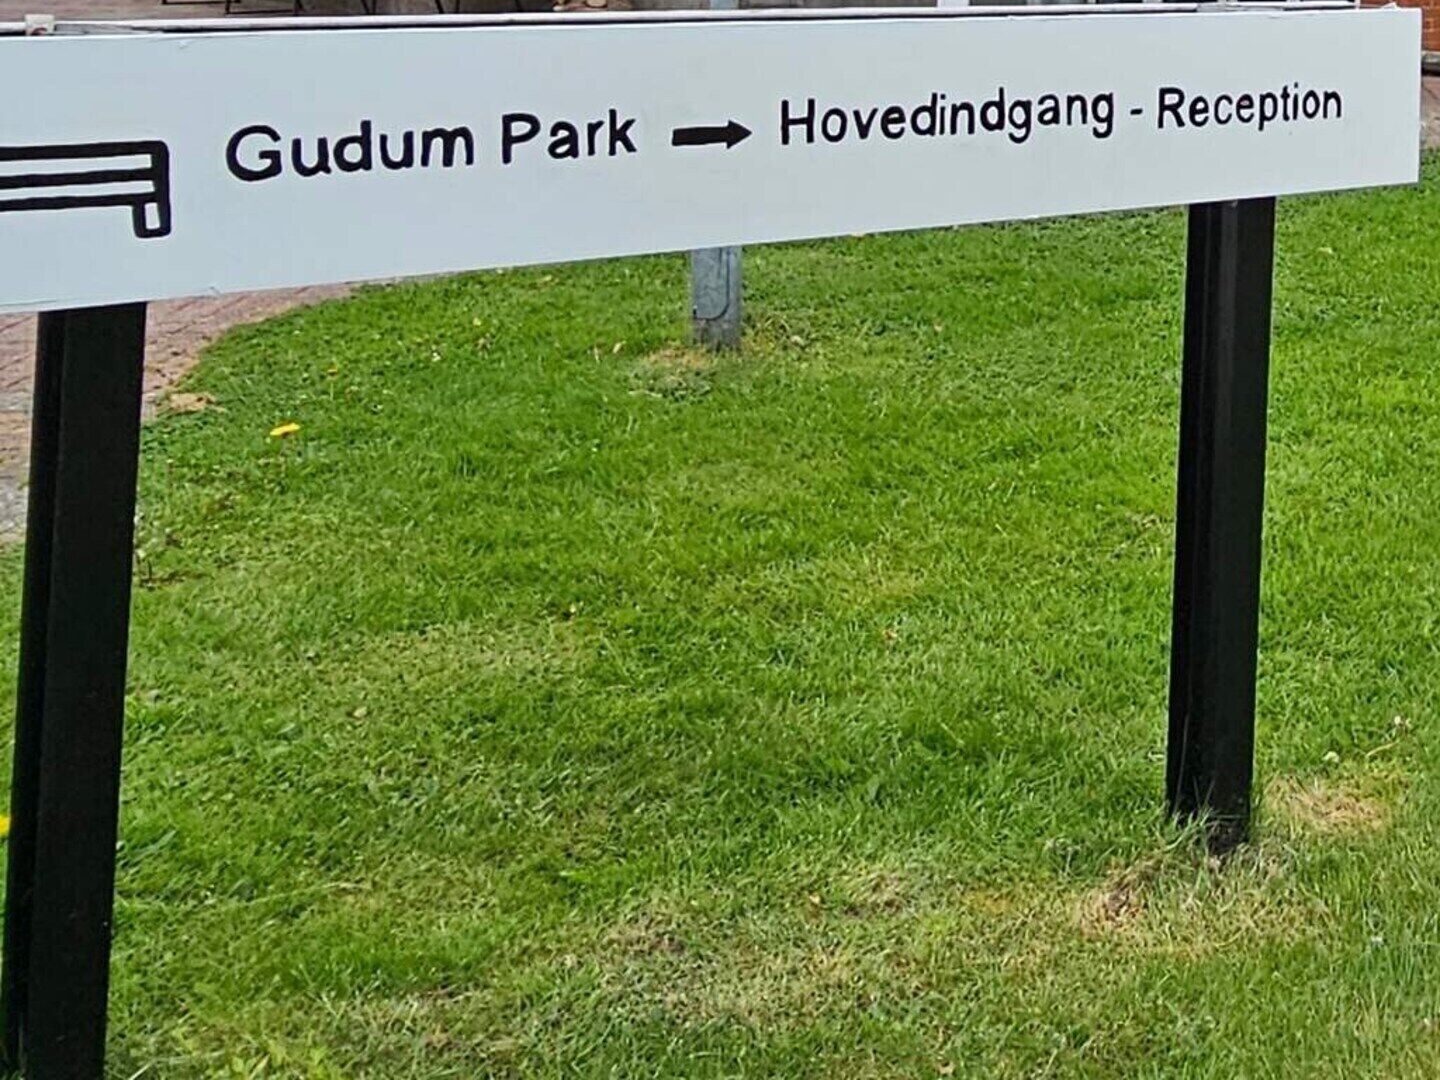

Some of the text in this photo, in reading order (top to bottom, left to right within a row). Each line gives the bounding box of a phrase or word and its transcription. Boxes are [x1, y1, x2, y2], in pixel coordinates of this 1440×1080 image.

[226, 119, 475, 183] Gudum
[501, 108, 637, 165] Park
[780, 86, 1114, 146] Hovedindgang
[1157, 84, 1342, 132] Reception
